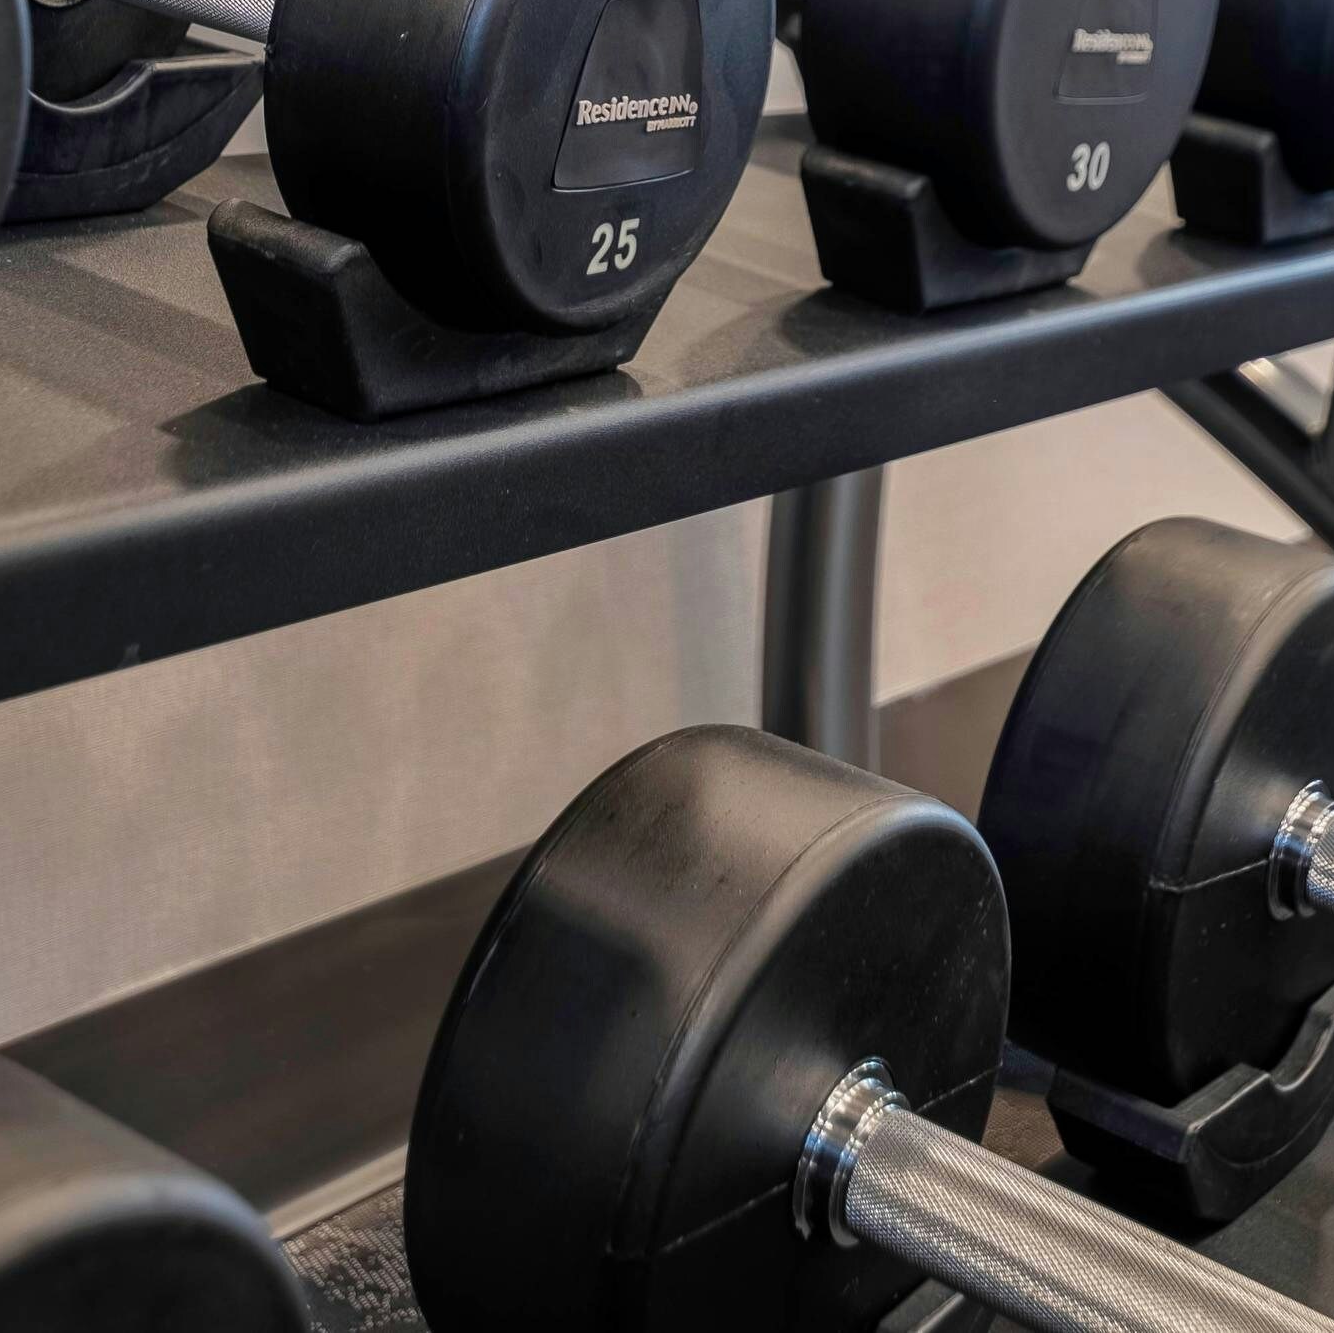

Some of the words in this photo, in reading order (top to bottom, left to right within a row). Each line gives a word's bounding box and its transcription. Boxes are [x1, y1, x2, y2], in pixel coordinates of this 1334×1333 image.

[576, 96, 669, 125] Residence
[1066, 141, 1110, 192] 30
[586, 218, 640, 275] 25
